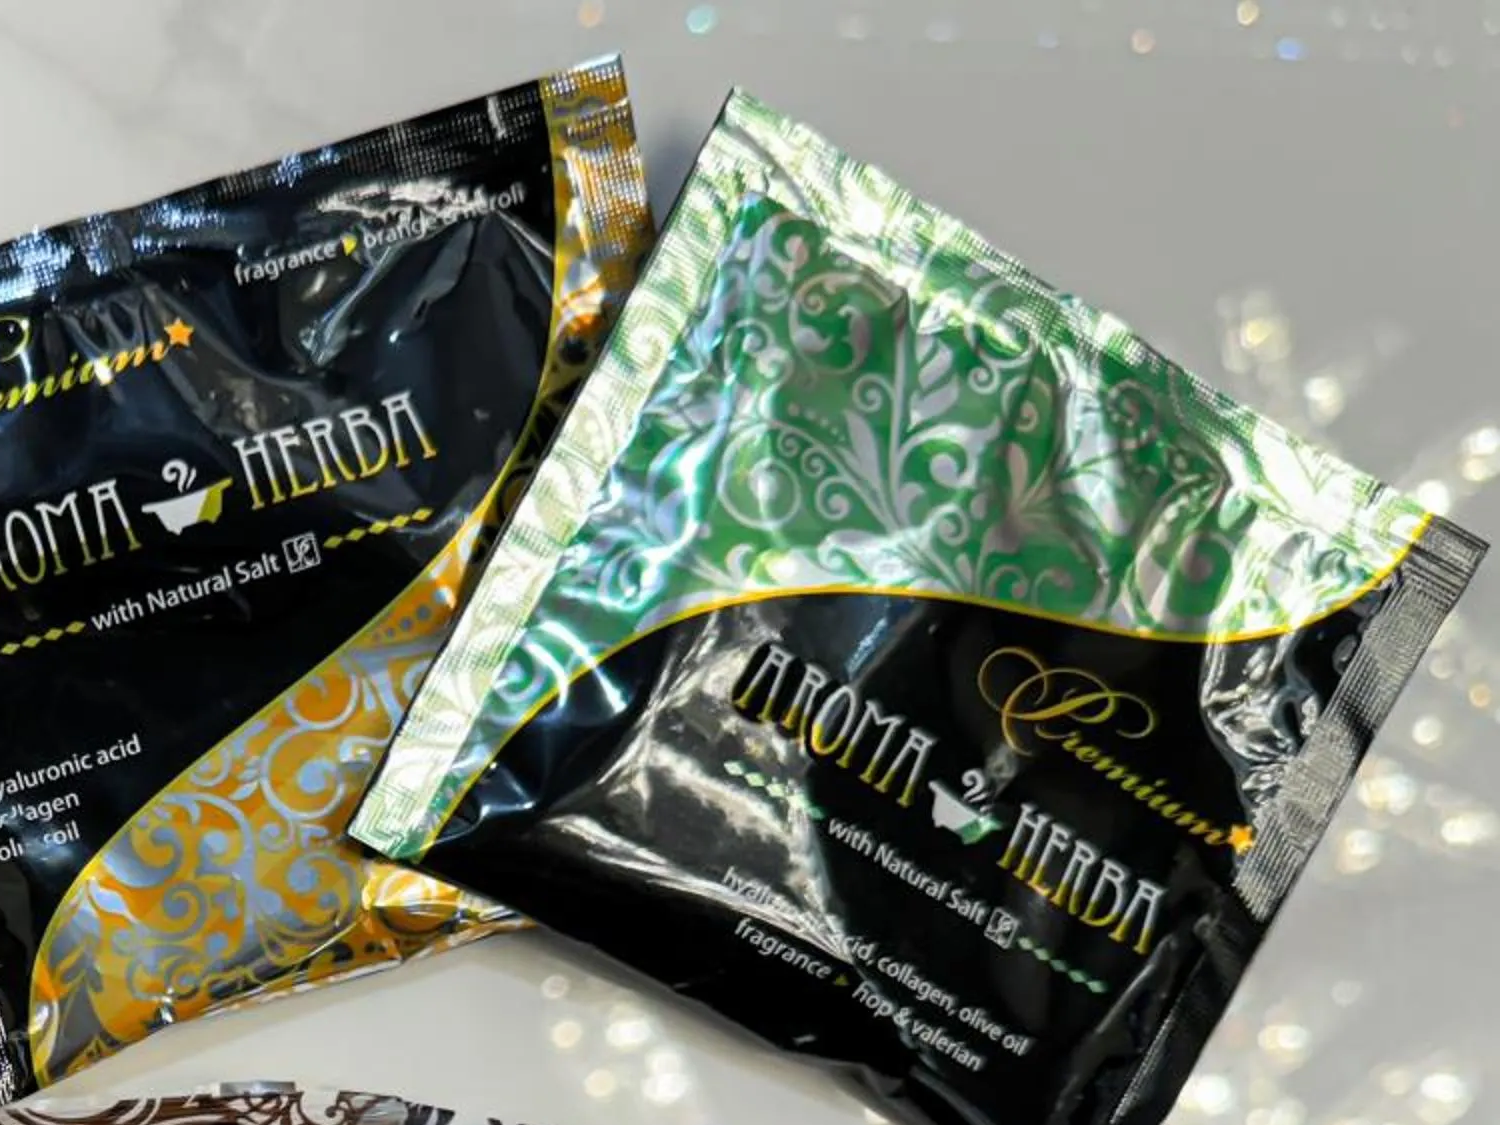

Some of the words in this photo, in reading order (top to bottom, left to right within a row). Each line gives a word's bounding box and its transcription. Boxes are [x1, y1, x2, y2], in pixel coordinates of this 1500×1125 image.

[234, 242, 337, 285] fragrance
[232, 390, 437, 511] HERBA
[92, 598, 143, 633] with
[146, 567, 233, 620] Natural
[235, 551, 281, 588] Salt
[97, 732, 142, 766] acid
[735, 640, 937, 808] AROMA
[996, 802, 1167, 957] HERBA
[977, 646, 1226, 847] Premium
[52, 820, 80, 845] oil
[828, 816, 874, 860] with
[873, 840, 948, 902] Natural
[946, 887, 987, 926] Salt
[734, 917, 833, 980] fragrance
[852, 980, 893, 1018] hop
[892, 1007, 911, 1029] &
[910, 1018, 984, 1072] valerian
[877, 954, 958, 1017] collagen,
[958, 1004, 1002, 1042] olive
[1002, 1033, 1031, 1057] oil
